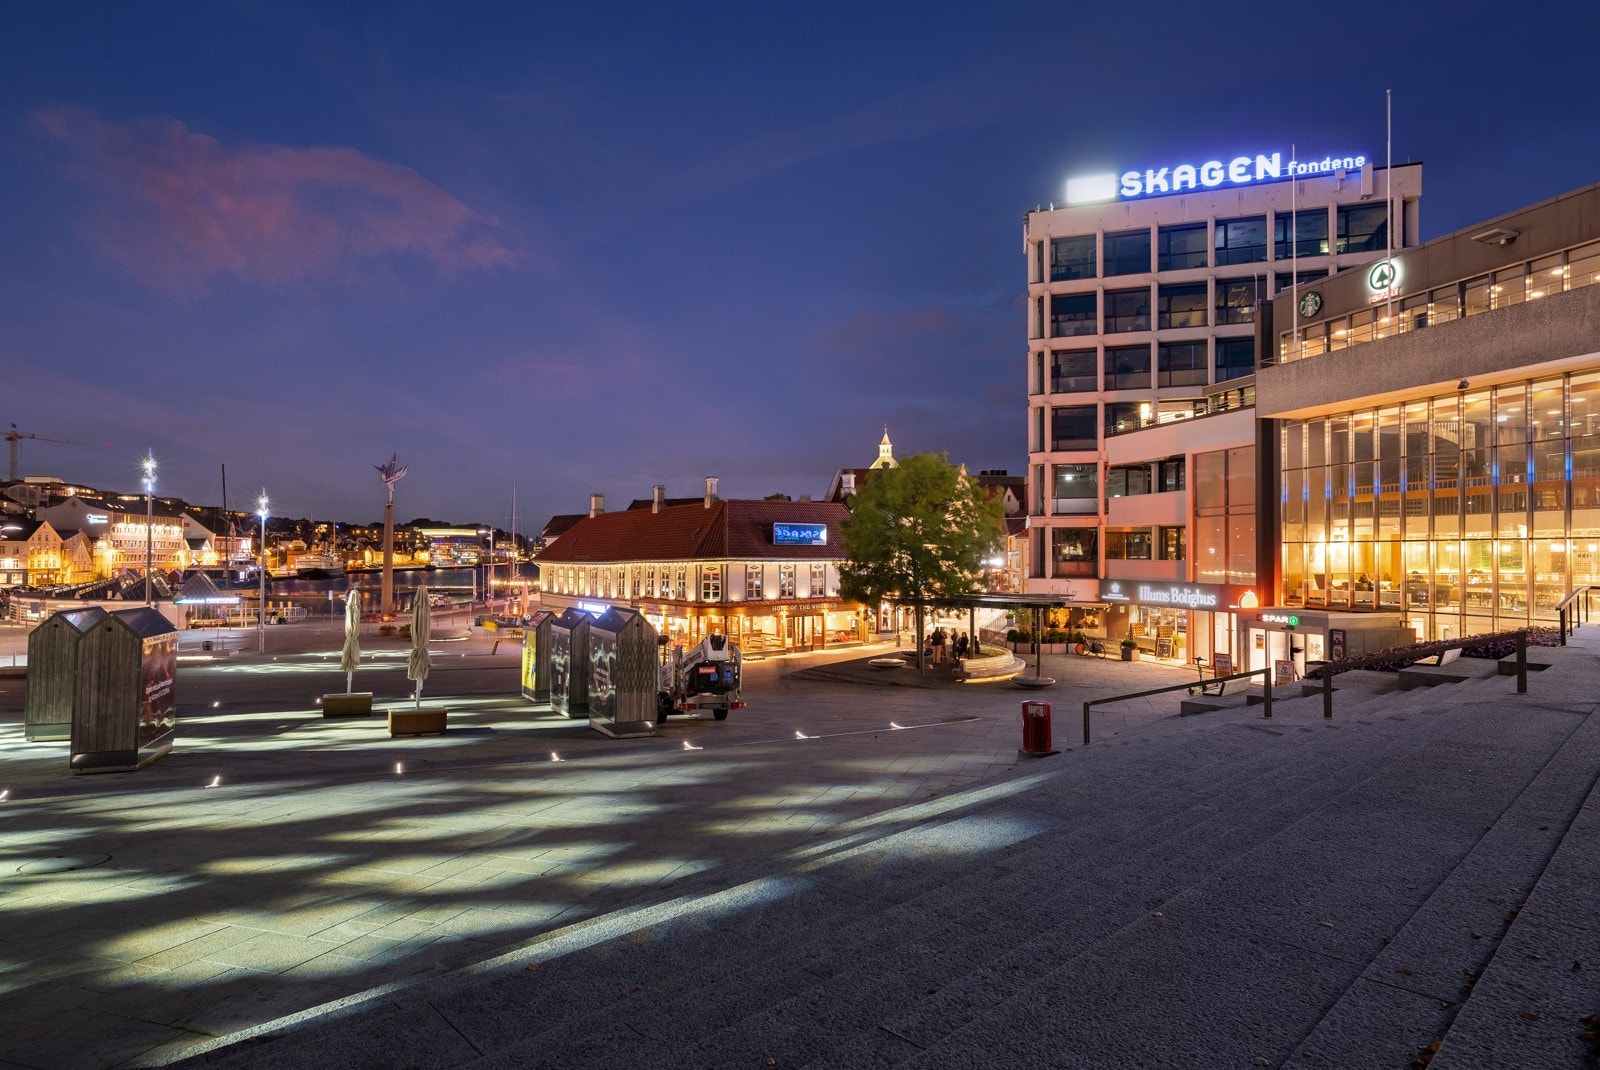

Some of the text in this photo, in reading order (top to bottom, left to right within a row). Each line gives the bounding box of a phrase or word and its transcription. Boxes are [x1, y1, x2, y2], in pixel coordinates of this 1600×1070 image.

[1120, 152, 1281, 197] SKAGEN
[1370, 288, 1400, 305] SPAR
[1139, 586, 1171, 602] Illums
[1171, 587, 1216, 607] Bolighus
[1262, 614, 1289, 624] SPAR
